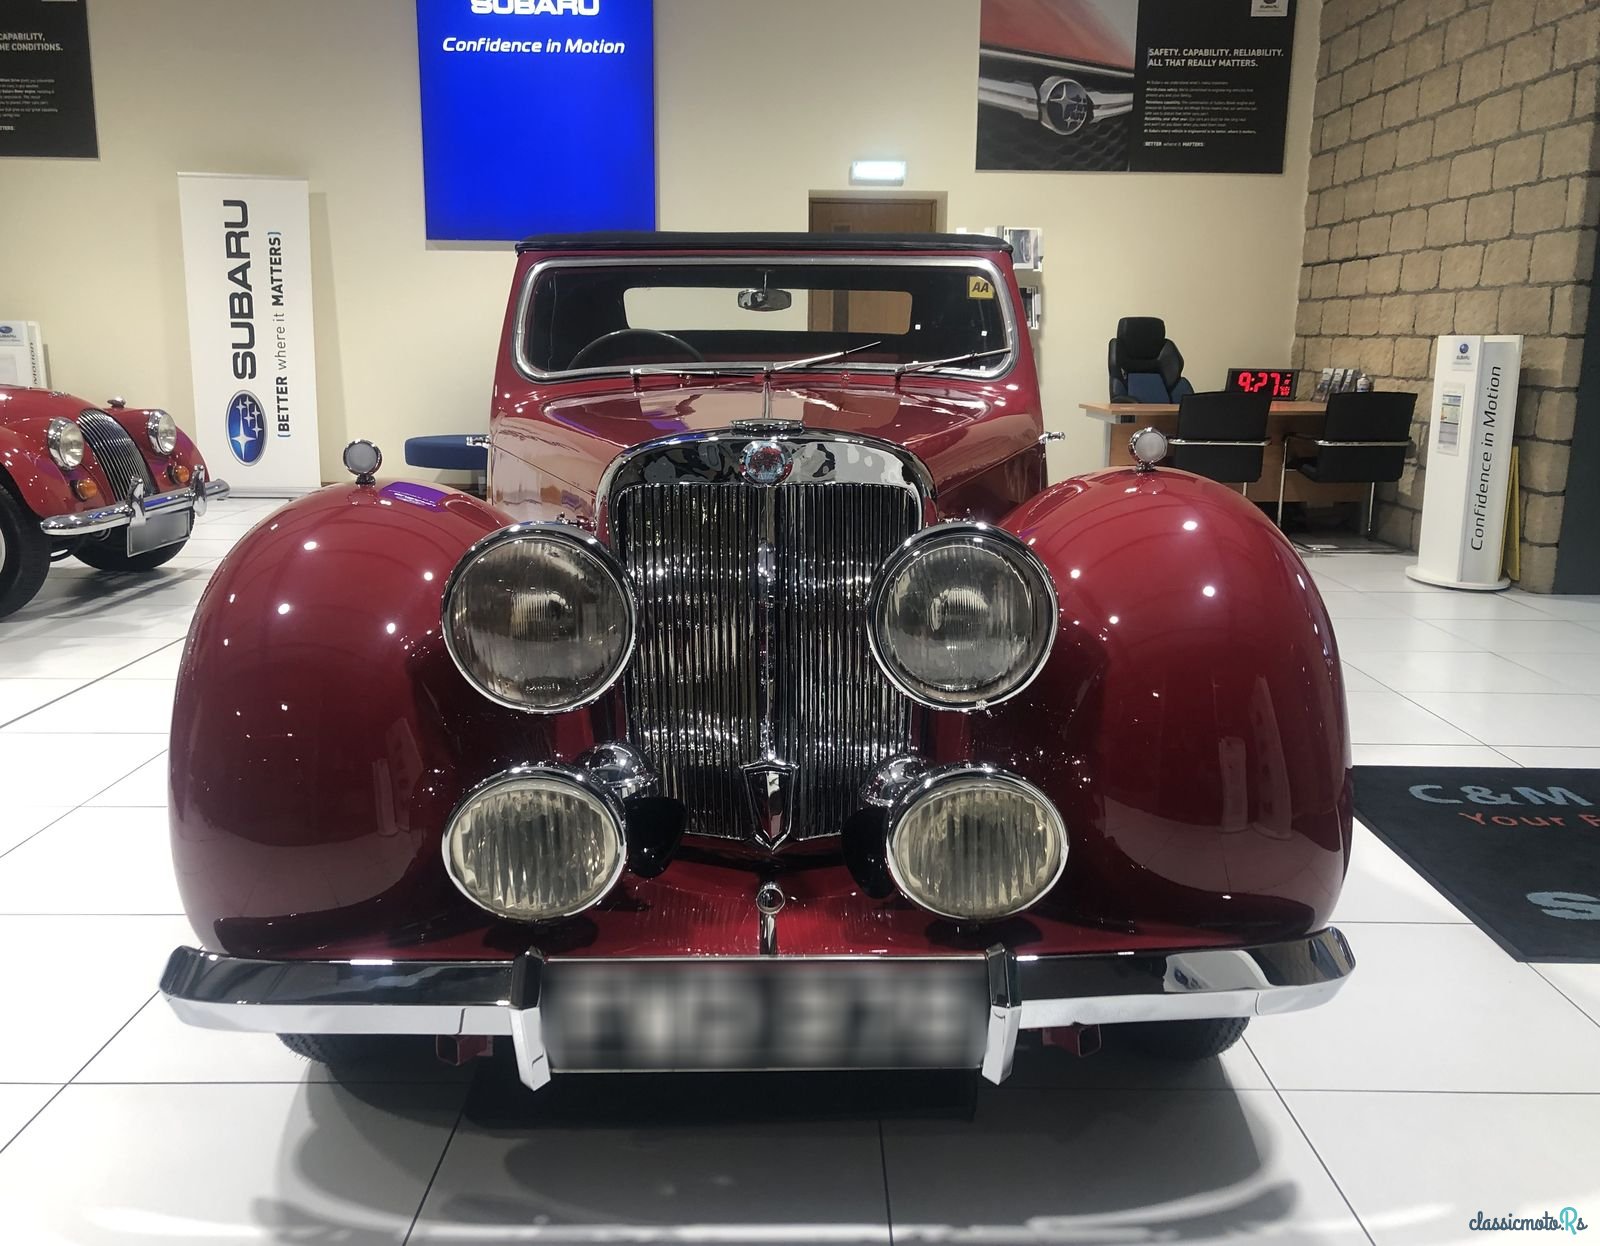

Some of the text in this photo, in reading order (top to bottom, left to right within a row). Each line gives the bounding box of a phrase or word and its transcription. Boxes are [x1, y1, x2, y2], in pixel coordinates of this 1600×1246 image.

[471, 0, 600, 16] SUBARU
[12, 43, 64, 51] CONDITIONS.
[443, 37, 625, 54] Confidence in Motion
[1183, 48, 1232, 57] CAPABILITY.
[1233, 49, 1284, 57] RELIABILITY.
[1148, 59, 1259, 67] ALL THAT REALLY MATTERS.
[223, 199, 257, 380] SUBARU
[972, 282, 989, 293] AA
[272, 312, 285, 323] it
[274, 326, 288, 370] where
[1238, 371, 1281, 396] 9:27
[1470, 366, 1501, 551] Confidence in Motion
[1408, 784, 1595, 806] C&M
[1459, 812, 1566, 827] Your
